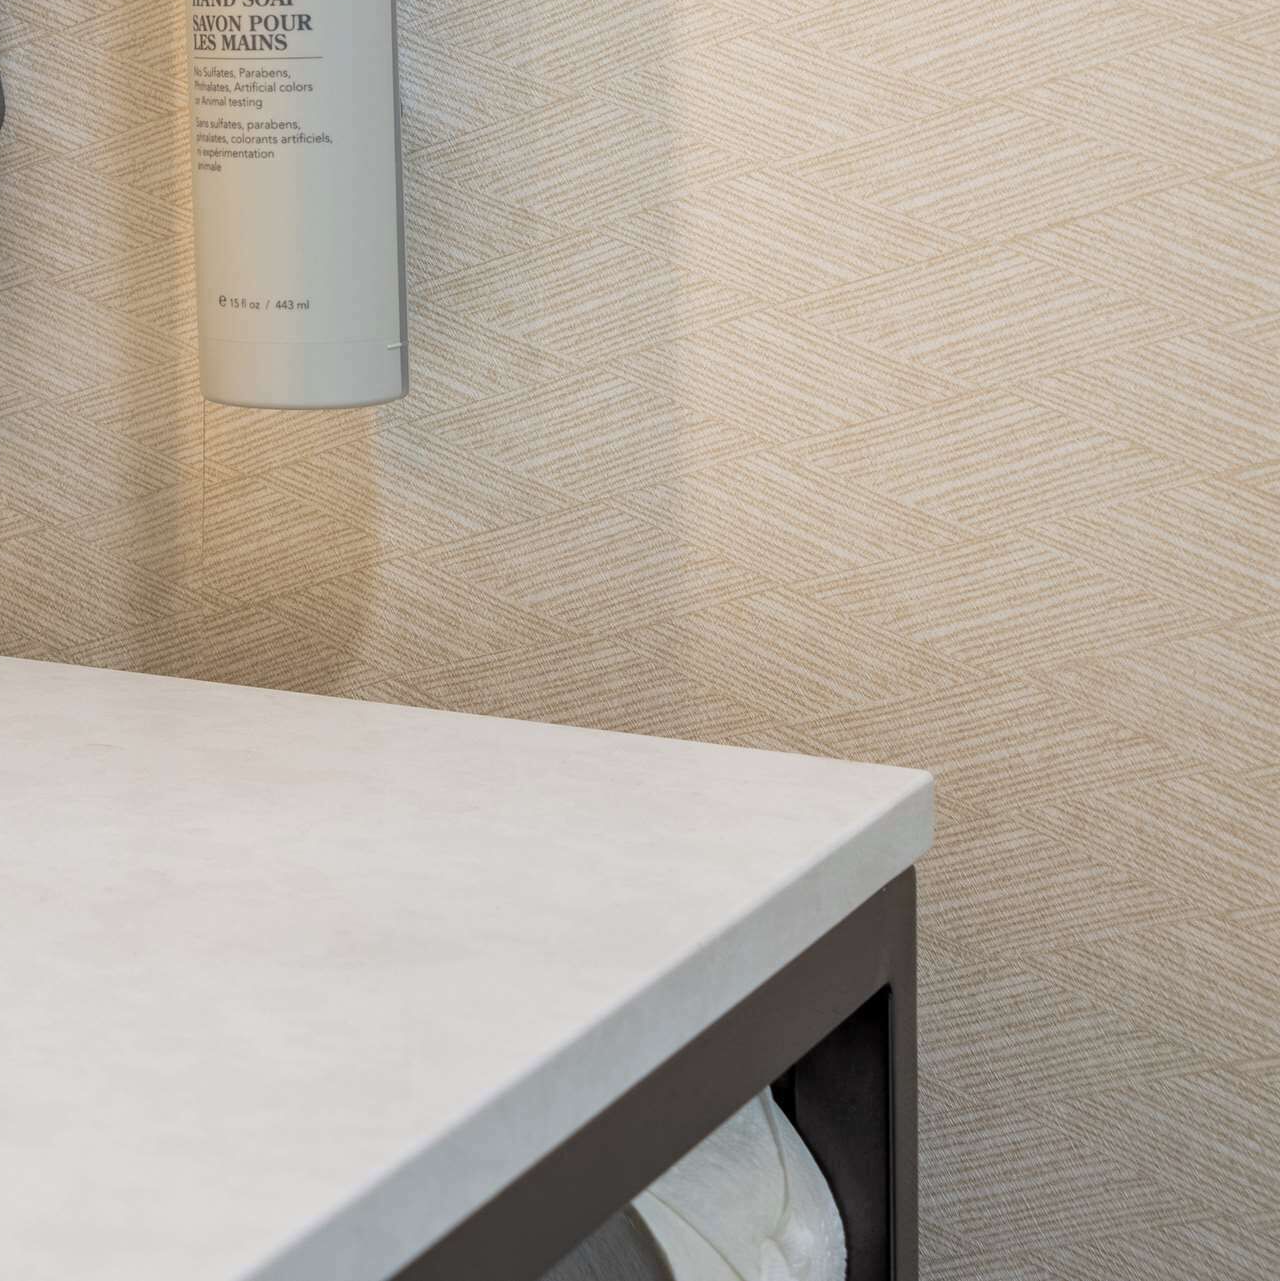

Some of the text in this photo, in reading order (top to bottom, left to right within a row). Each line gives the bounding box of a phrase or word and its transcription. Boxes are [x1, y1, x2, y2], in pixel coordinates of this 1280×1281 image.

[193, 14, 312, 32] SAVON POUR
[194, 34, 288, 50] LES MAINS
[239, 68, 291, 79] Parabens,
[235, 82, 276, 92] Artificial
[279, 82, 313, 92] colors
[229, 98, 262, 109] testing
[248, 119, 300, 131] parabens,
[231, 135, 278, 144] colorants
[281, 133, 333, 144] artificiels,
[276, 300, 294, 309] 443
[297, 300, 309, 309] ml
